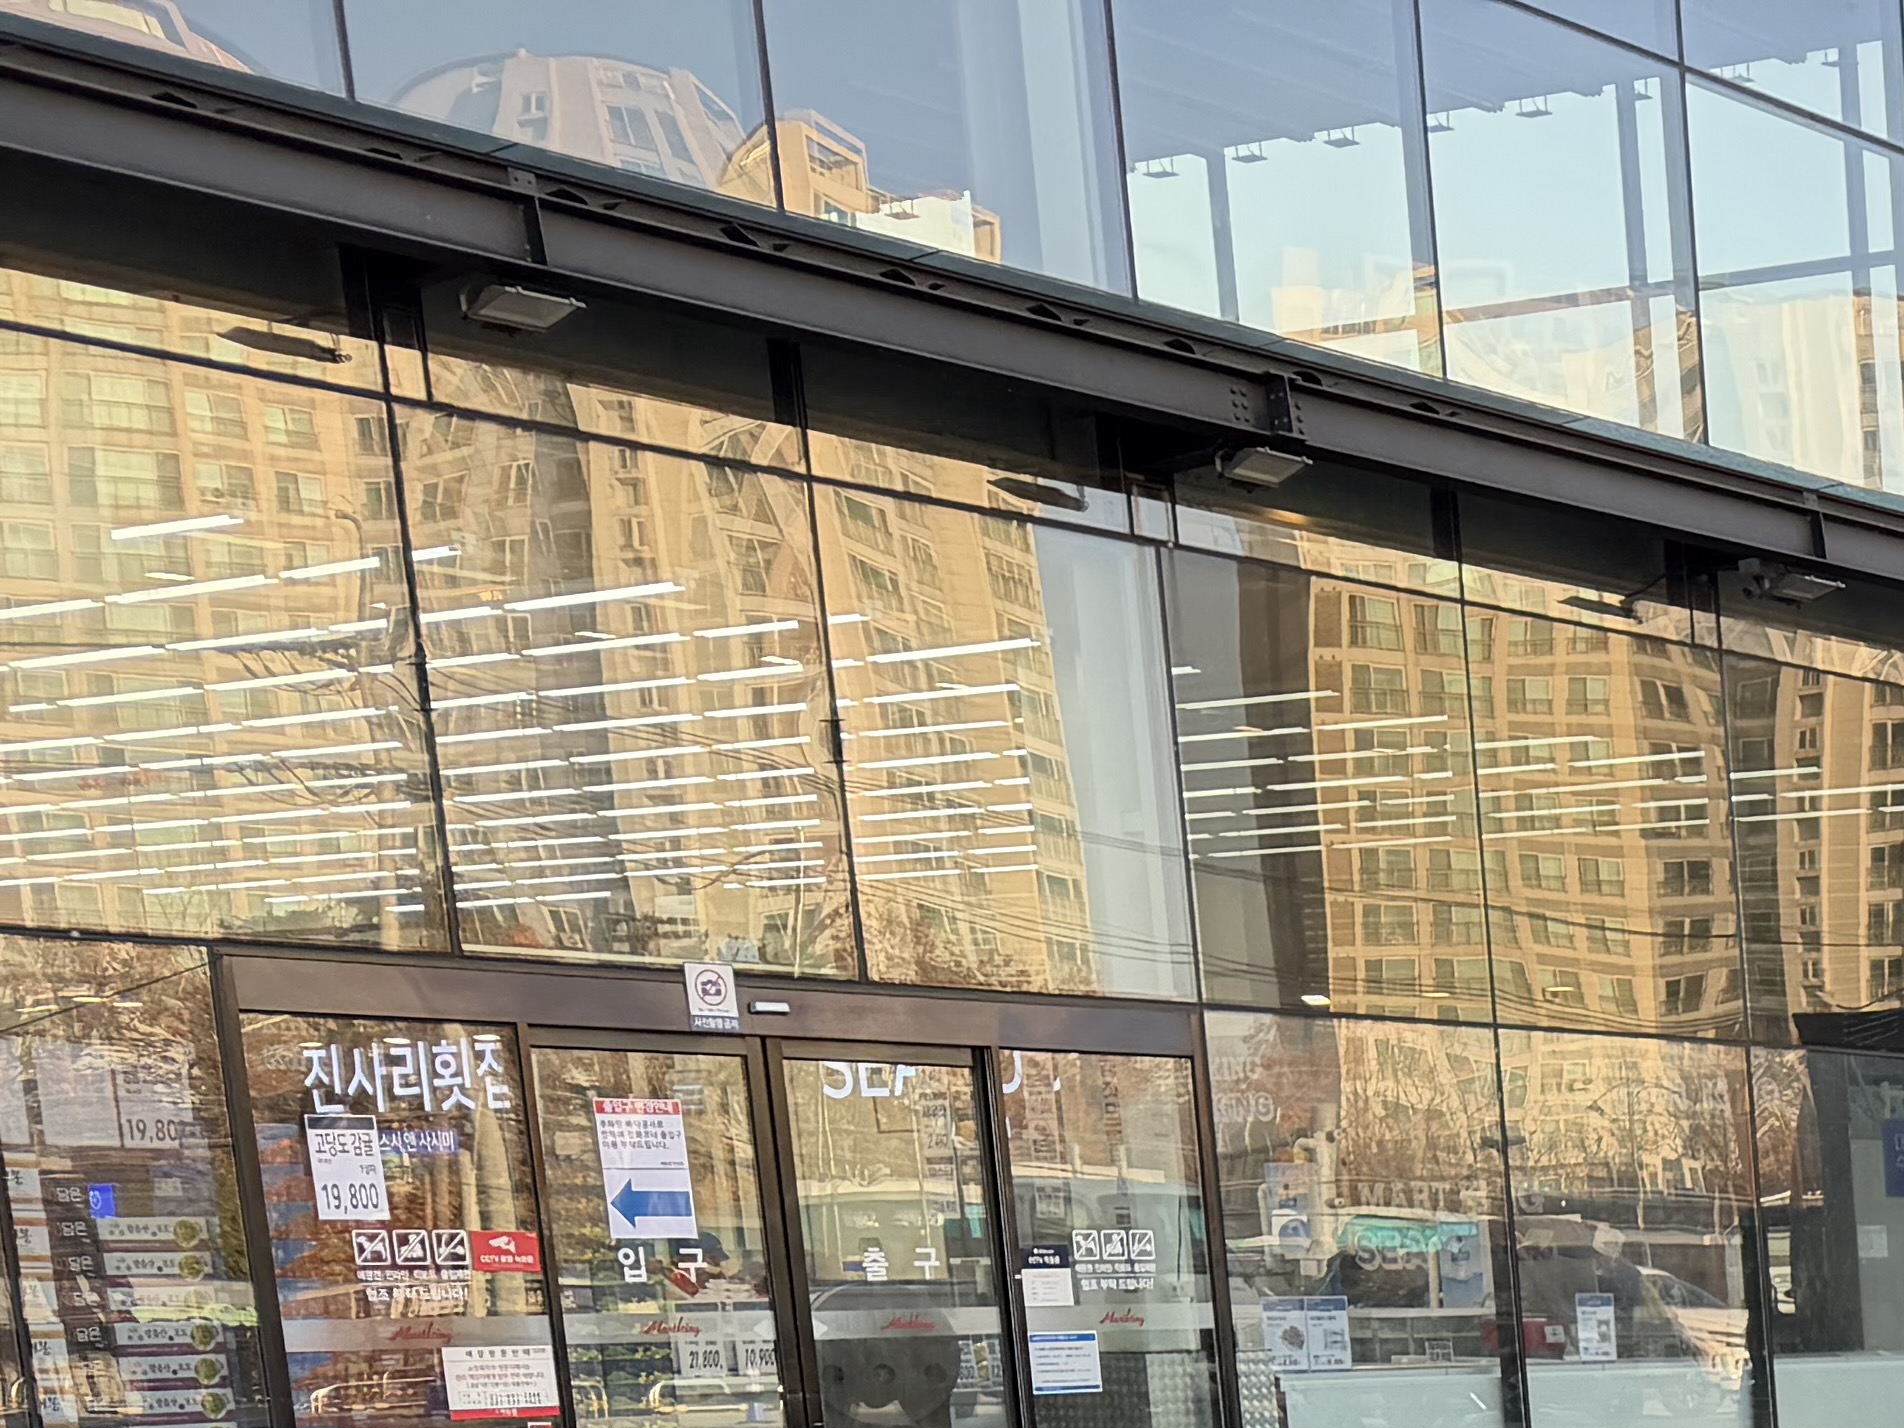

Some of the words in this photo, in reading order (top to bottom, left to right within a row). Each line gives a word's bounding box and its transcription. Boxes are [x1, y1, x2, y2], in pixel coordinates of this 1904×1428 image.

[314, 1132, 350, 1157] 고당도
[350, 1132, 375, 1157] 감귤
[420, 1130, 455, 1152] 사시미
[321, 1182, 379, 1214] 19,800
[617, 1246, 708, 1283] 입구
[862, 1247, 941, 1282] 출구
